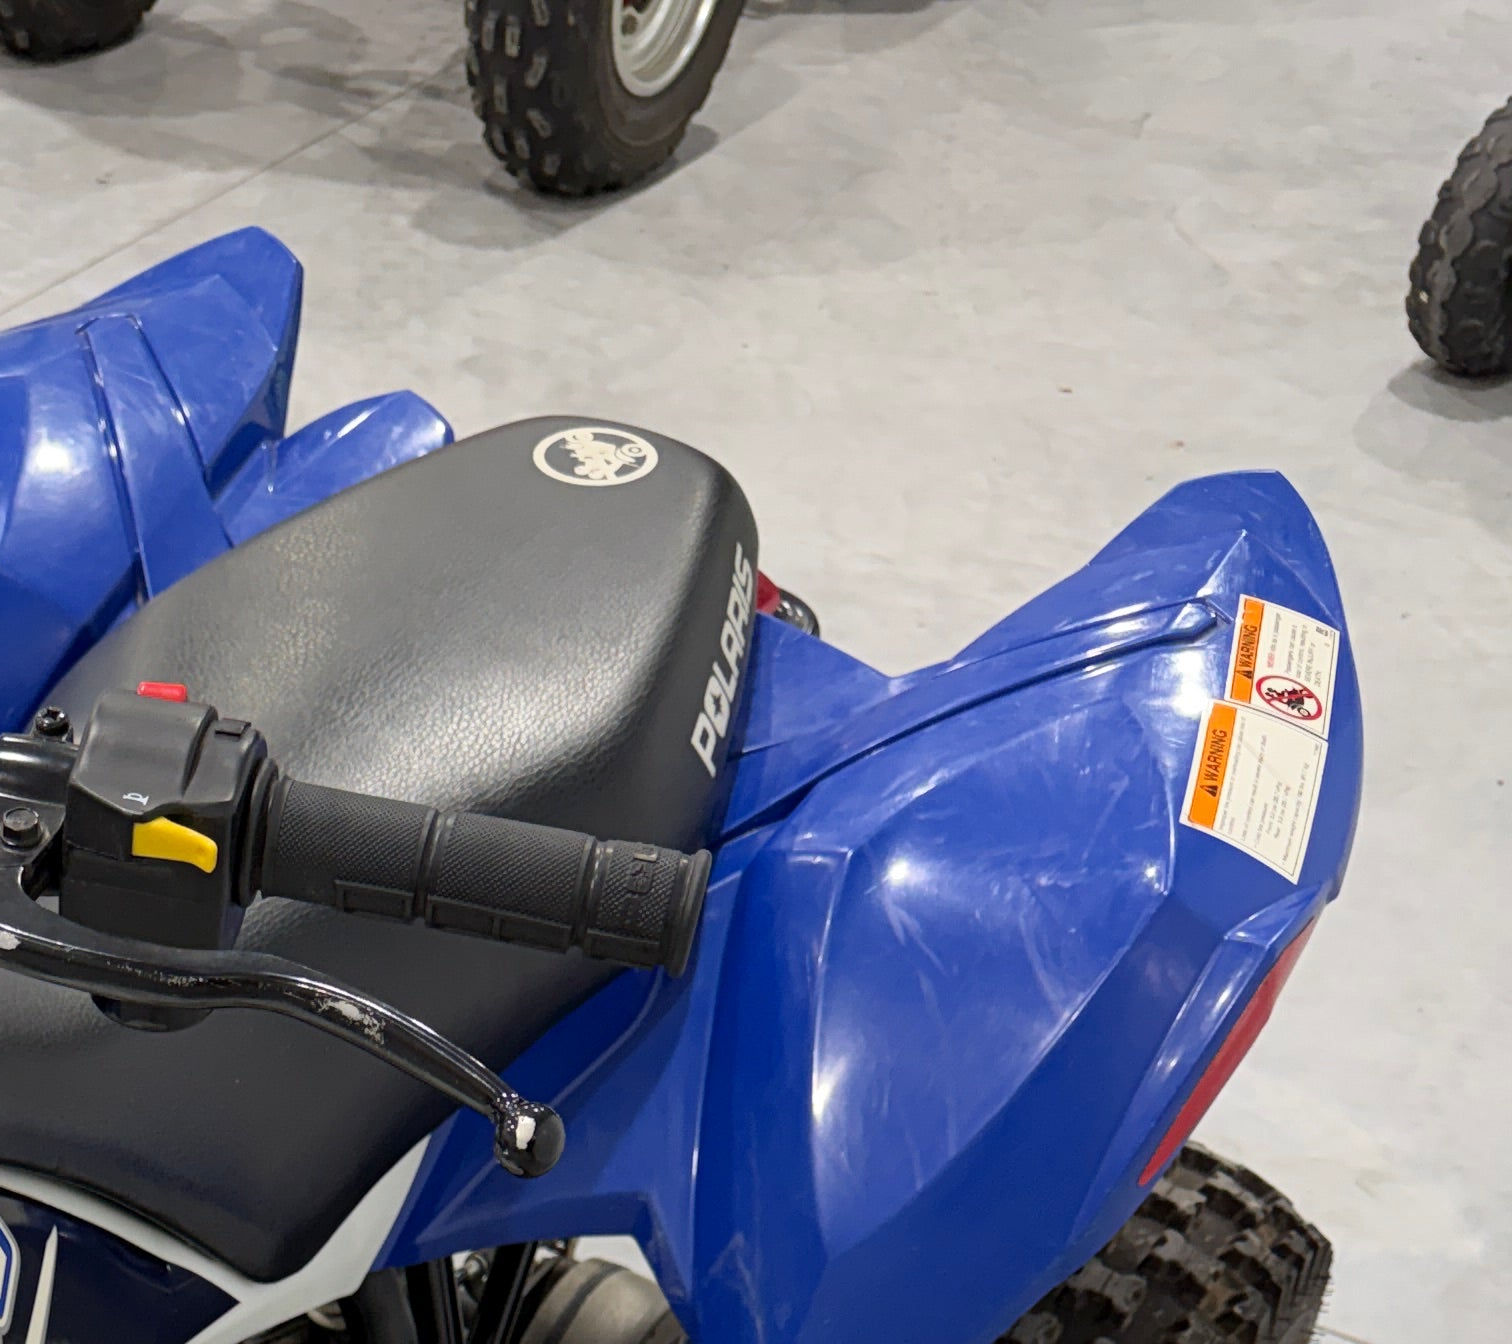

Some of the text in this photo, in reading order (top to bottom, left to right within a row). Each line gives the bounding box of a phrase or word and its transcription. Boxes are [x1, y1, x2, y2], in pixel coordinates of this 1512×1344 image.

[691, 542, 756, 779] POLARIS
[1238, 624, 1258, 668] WARNING
[1204, 729, 1227, 780] WARNING
